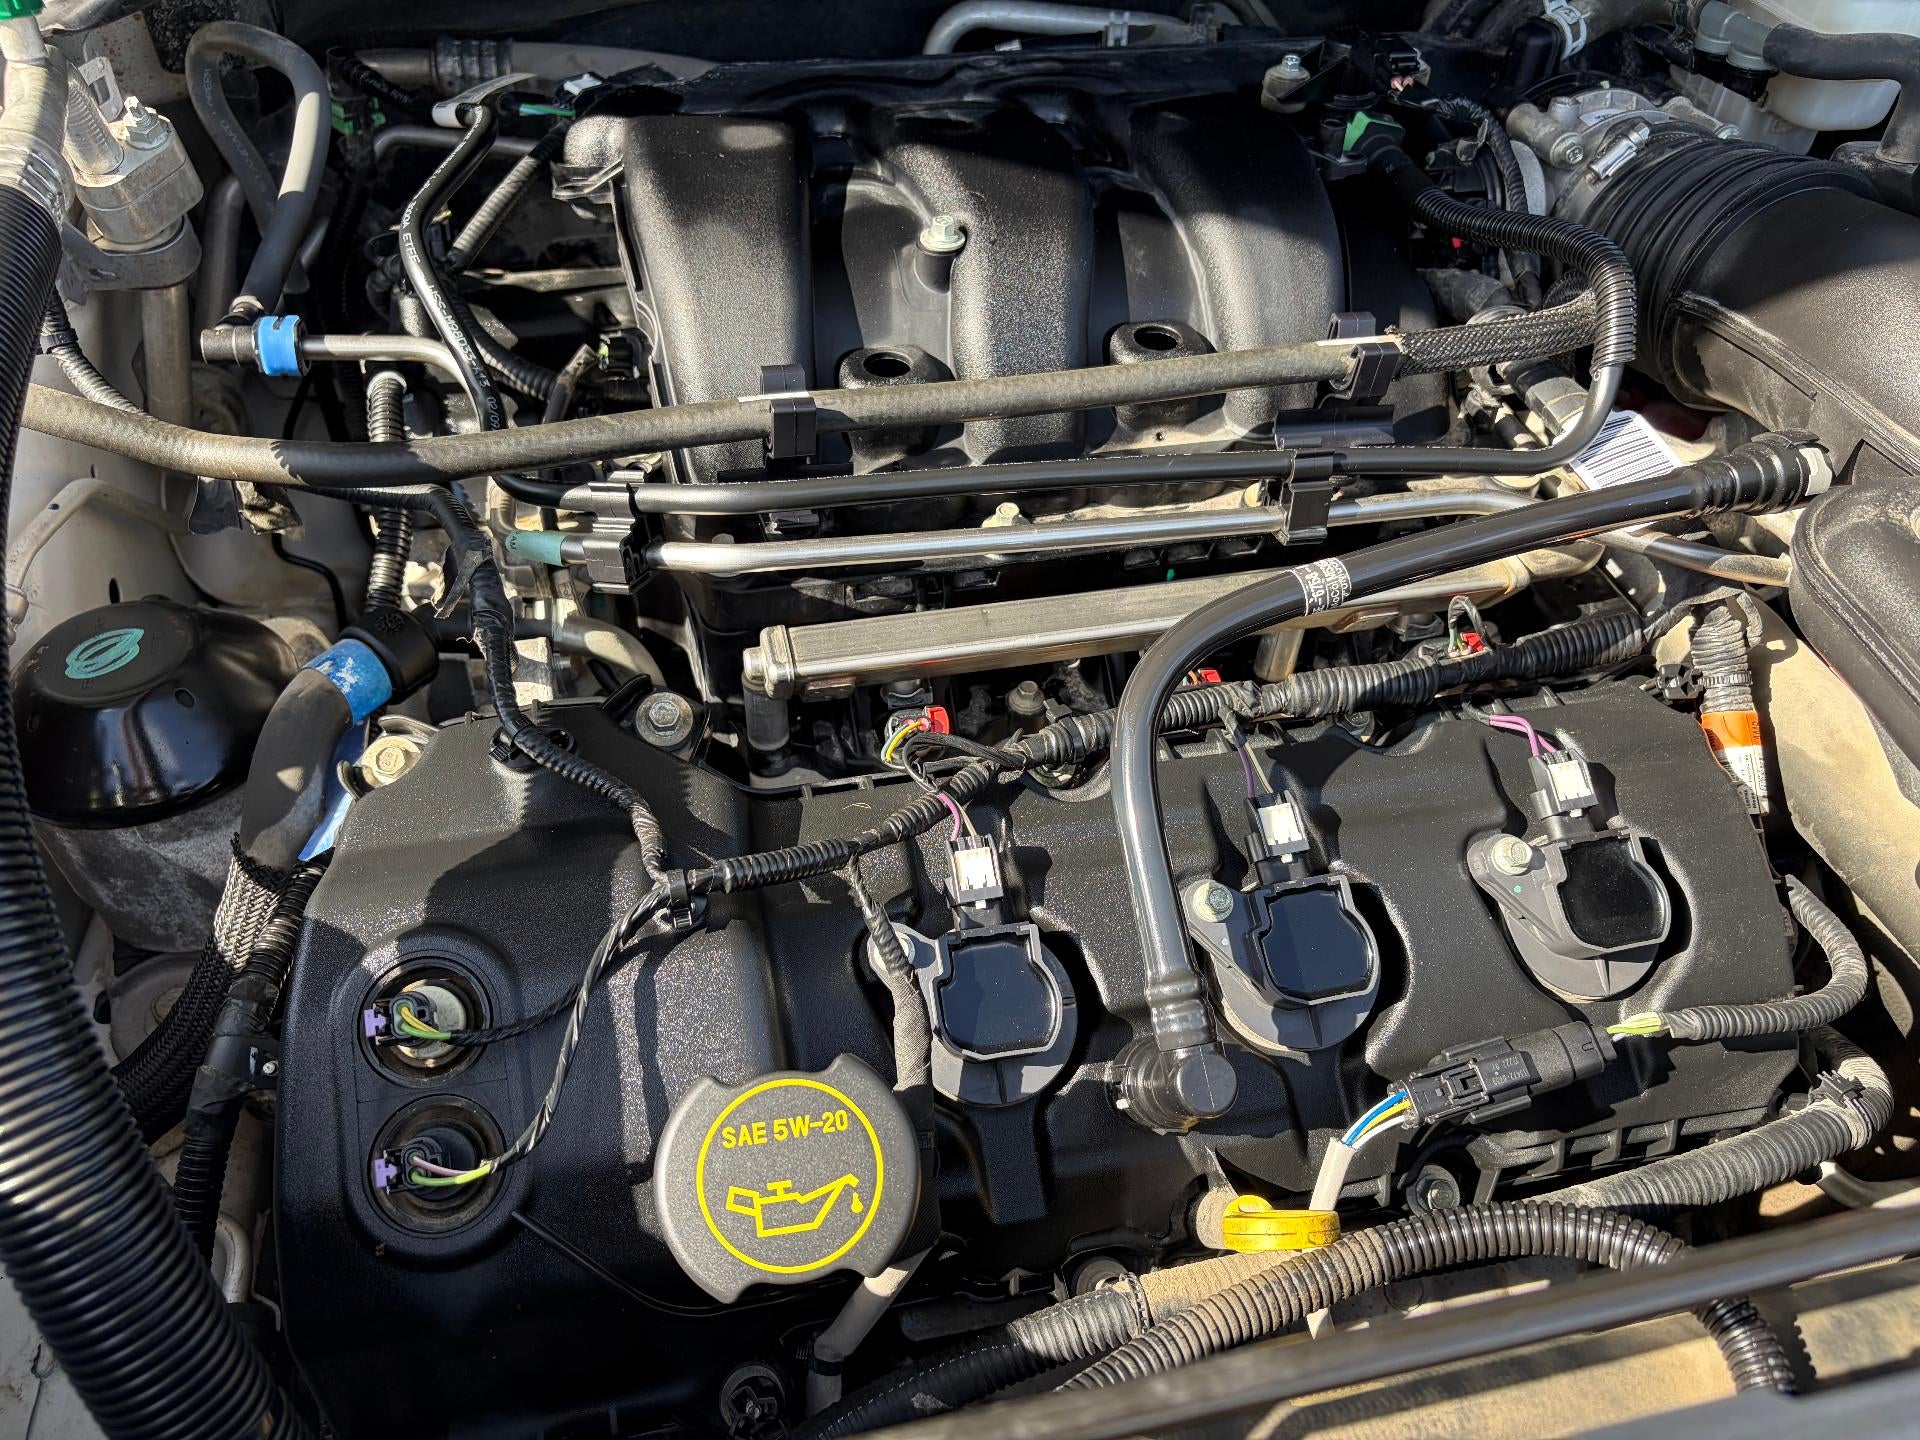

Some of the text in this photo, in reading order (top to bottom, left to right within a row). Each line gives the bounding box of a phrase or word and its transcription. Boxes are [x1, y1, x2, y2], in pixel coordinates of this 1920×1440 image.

[402, 232, 420, 263] ETFE
[722, 1109, 849, 1149] SAE 5W-20
